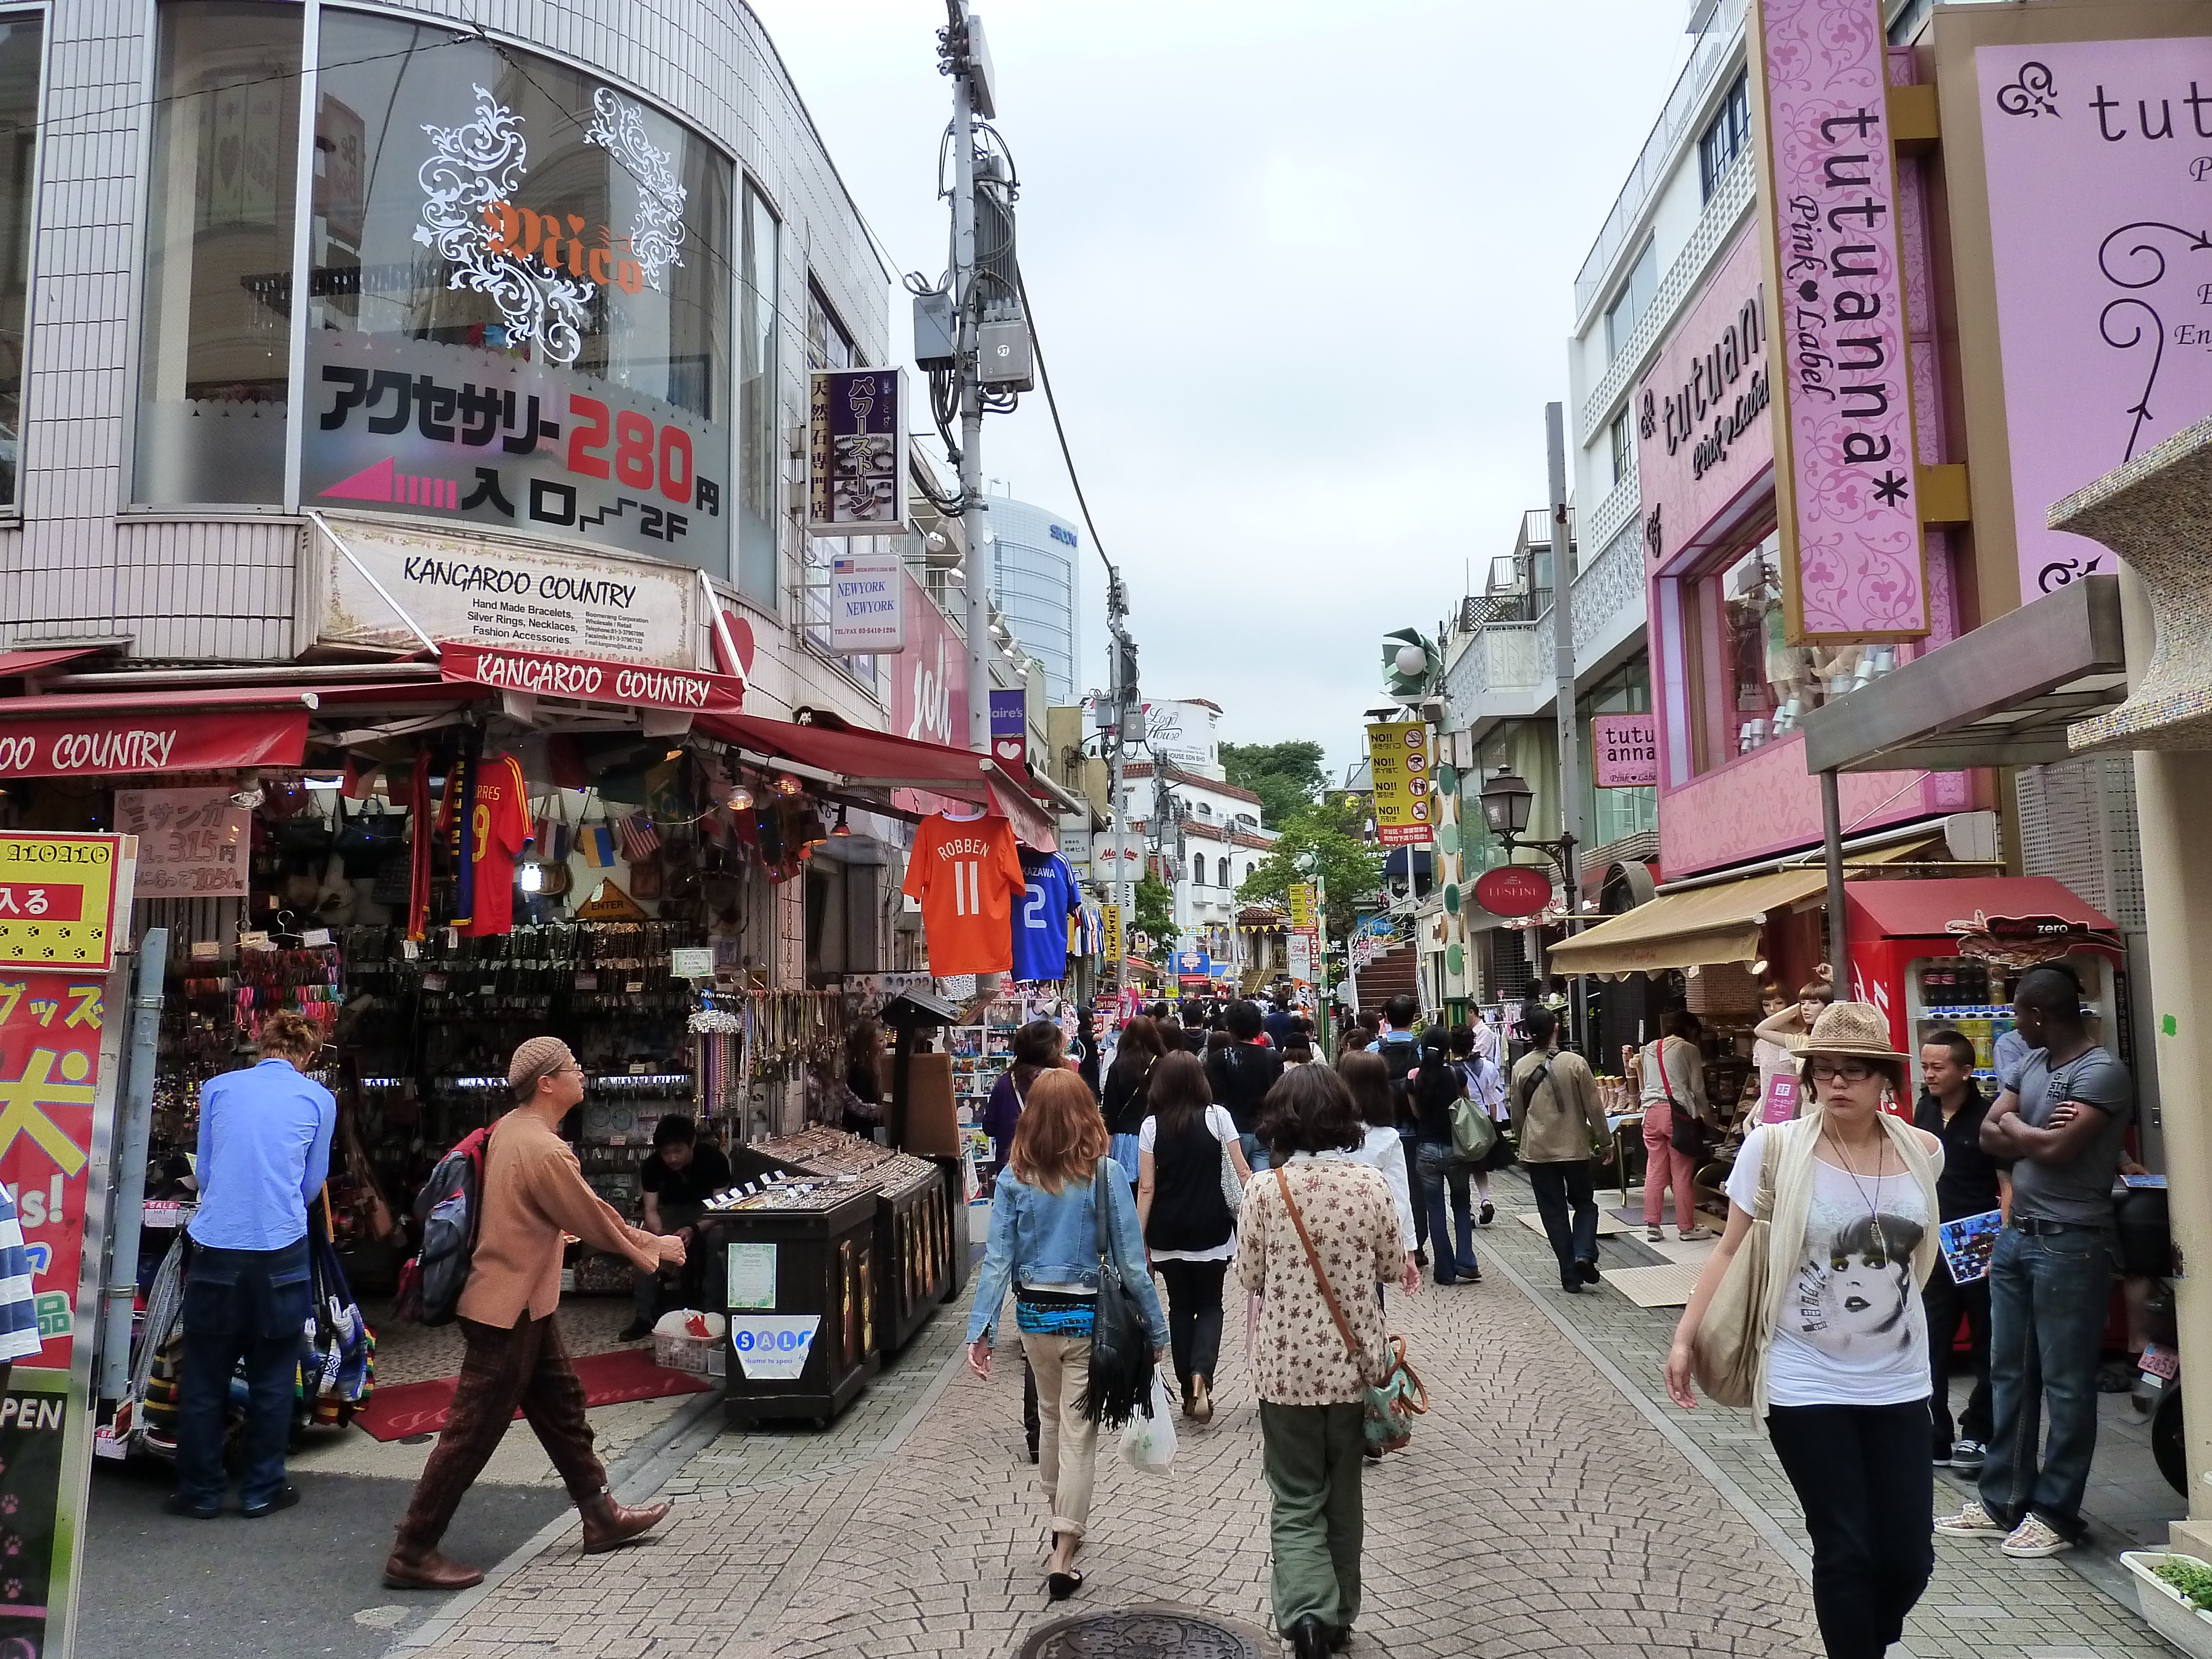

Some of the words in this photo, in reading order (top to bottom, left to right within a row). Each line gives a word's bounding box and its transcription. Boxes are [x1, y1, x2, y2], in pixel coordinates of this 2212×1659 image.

[1788, 195, 1828, 280] Pink
[1793, 306, 1835, 401] Label
[811, 380, 828, 519] 天然石専門店
[848, 376, 876, 517] パワーストーン
[1692, 415, 1726, 480] Pink
[461, 467, 577, 527] 入口
[641, 504, 688, 542] 2F
[1050, 524, 1077, 547] SECOM
[404, 556, 531, 596] KANGAROO
[539, 575, 636, 609] COUNTRY
[837, 581, 886, 598] NEWYORK
[473, 598, 498, 611] Hand
[500, 602, 525, 614] Made
[528, 604, 575, 620] Bracelets,
[586, 611, 617, 621] Boomerang
[618, 615, 649, 624] Corporation
[846, 600, 896, 617] NEWYORK
[467, 611, 495, 623] Silver
[496, 614, 526, 628] Rings,
[528, 618, 578, 633] Necklaces,
[586, 618, 613, 627] Wholesale
[473, 625, 510, 639] Fashion
[513, 629, 572, 644] Accessories.
[476, 653, 603, 695] KANGAROO
[615, 670, 710, 708] COUNTRY
[990, 707, 1023, 718] aire's
[1146, 708, 1179, 726] Logo
[1145, 723, 1183, 741] House
[1371, 734, 1393, 742] NO!!
[1605, 727, 1654, 744] tutu
[51, 730, 176, 770] COUNTRY
[1607, 747, 1655, 762] anna
[1374, 758, 1395, 766] NO!!
[1376, 782, 1397, 791] NO!!
[1610, 773, 1632, 783] Pink
[1379, 806, 1400, 815] NO!!
[472, 804, 491, 863] 9
[937, 838, 990, 861] ROBBEN
[954, 860, 980, 916] 11
[0, 888, 49, 915] 入る
[591, 900, 624, 910] ENTER
[1024, 884, 1047, 928] 2
[1107, 909, 1117, 935] JEANS
[2037, 925, 2068, 933] zero
[1108, 935, 1117, 958] MATE
[1777, 1086, 1789, 1094] 2F
[1, 1397, 63, 1431] PEN
